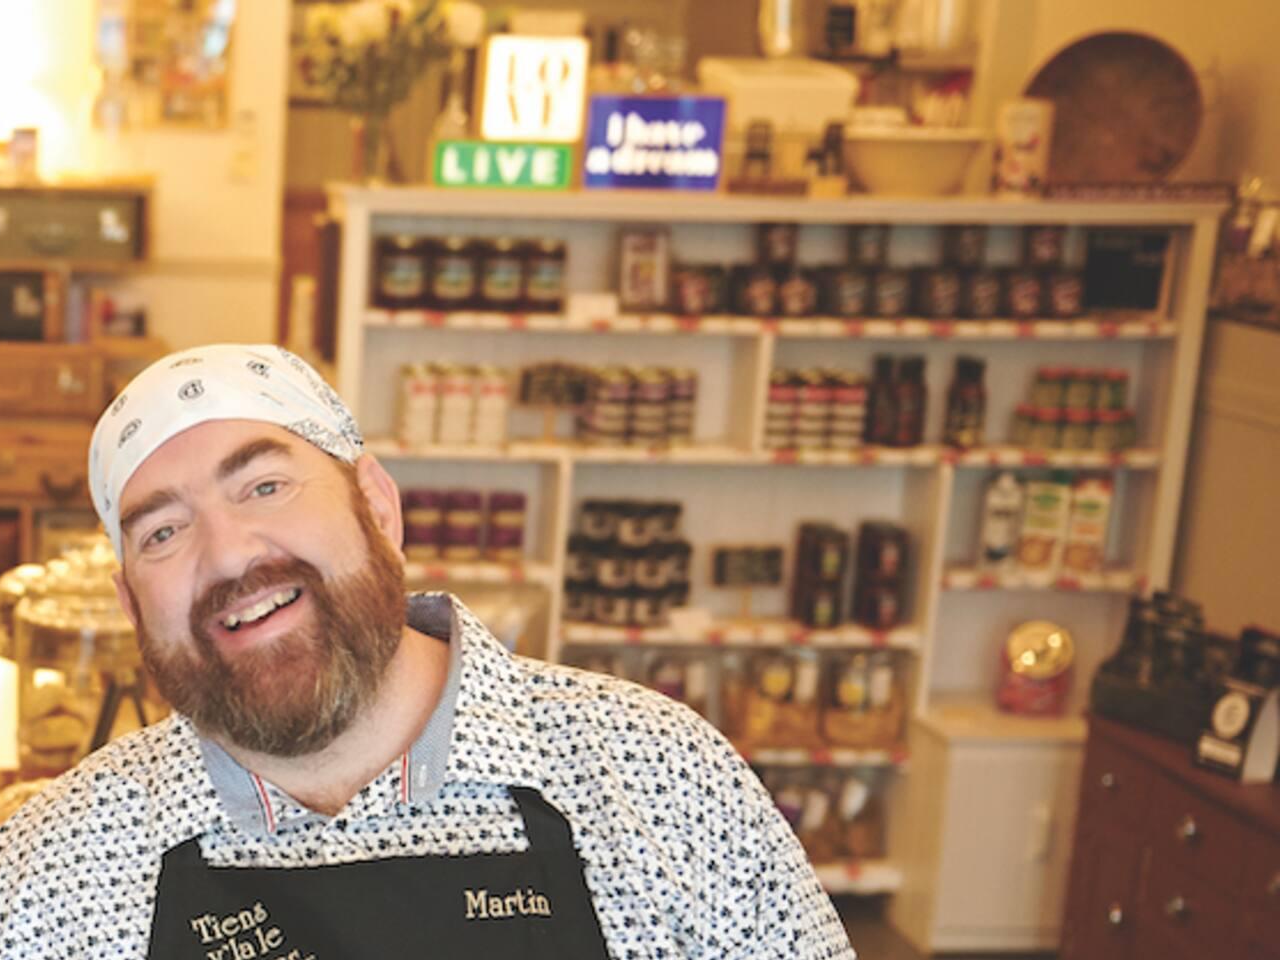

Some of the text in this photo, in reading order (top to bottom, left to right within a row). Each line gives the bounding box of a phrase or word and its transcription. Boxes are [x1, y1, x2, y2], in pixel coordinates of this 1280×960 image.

[440, 145, 560, 185] LIVE
[191, 901, 268, 944] Tiens
[463, 886, 552, 920] Martin
